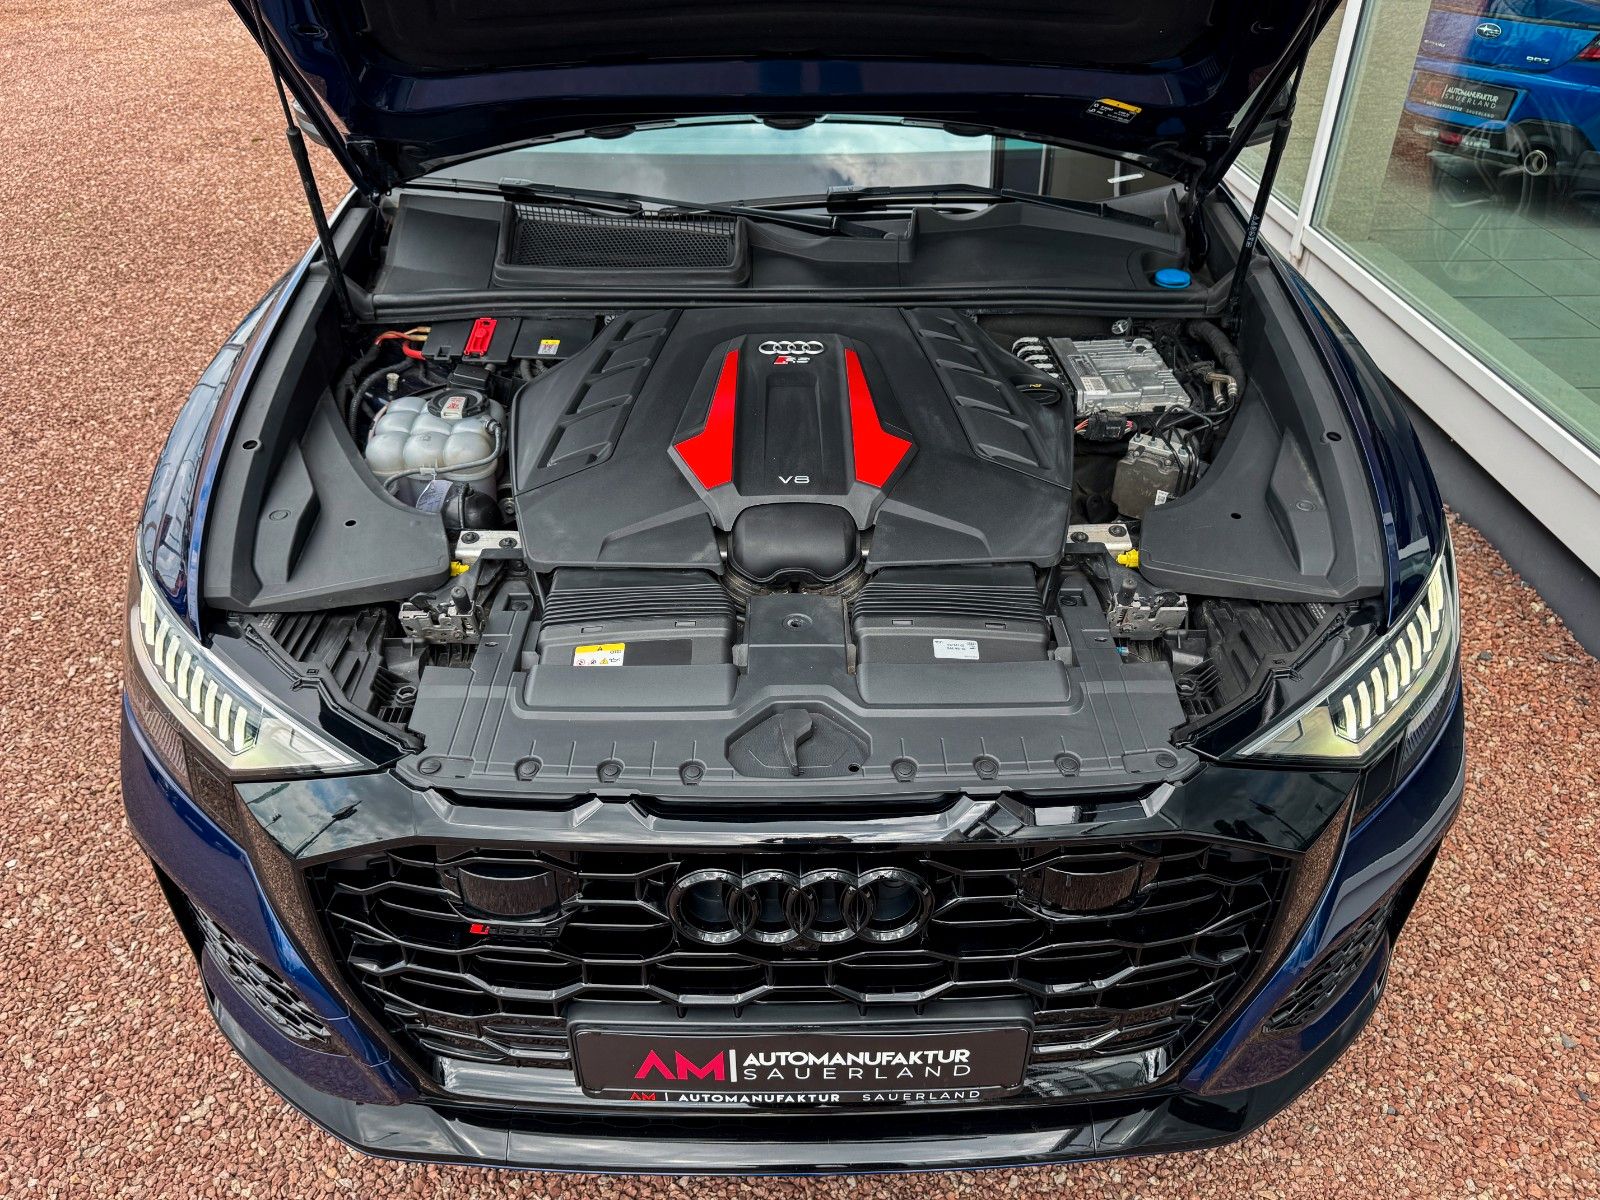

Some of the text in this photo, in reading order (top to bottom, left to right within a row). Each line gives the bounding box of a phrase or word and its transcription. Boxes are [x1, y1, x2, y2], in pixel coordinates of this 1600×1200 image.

[1444, 94, 1496, 109] SAUERLAND
[1447, 86, 1499, 103] AUTOMANUFAKTUR
[778, 475, 810, 484] V8
[743, 1049, 970, 1067] AUTOMANUFAKTUR
[743, 1065, 970, 1081] SAUERLAND
[678, 1094, 840, 1103] AUTOMANUFAKTUR
[862, 1090, 980, 1101] SAUERLAND
